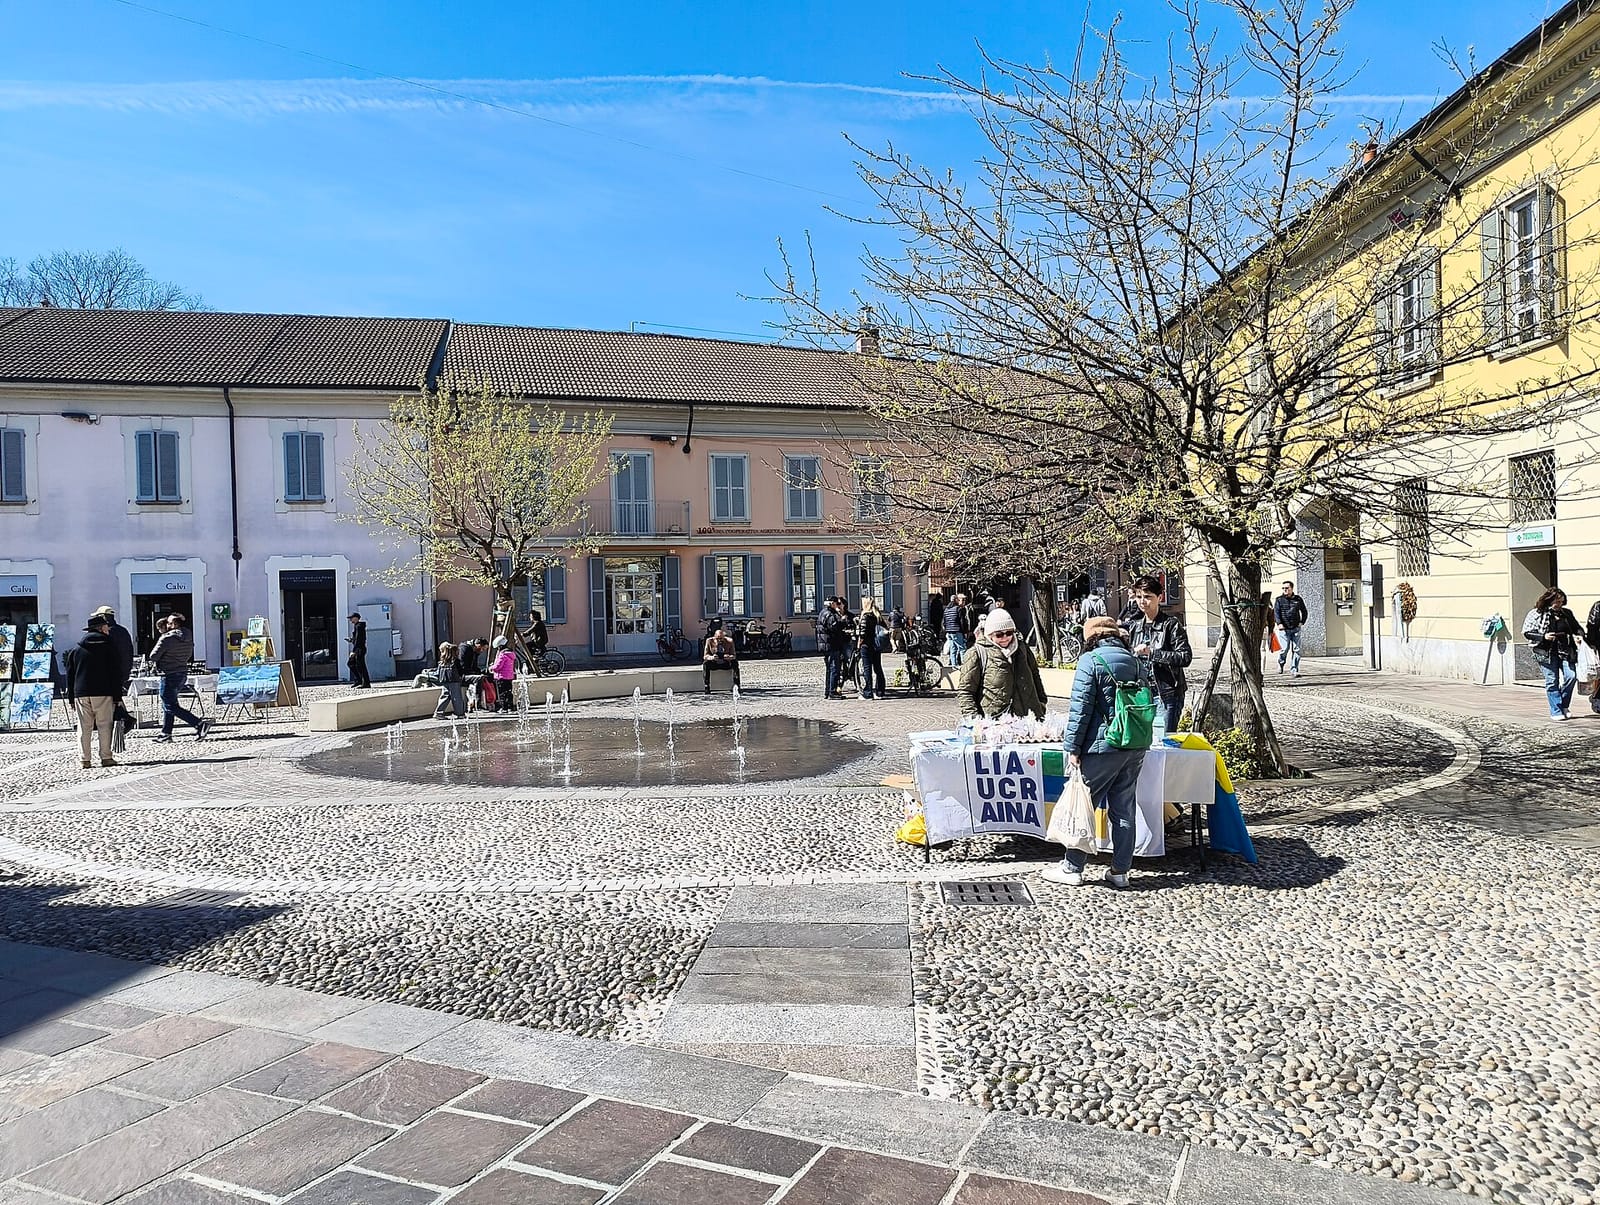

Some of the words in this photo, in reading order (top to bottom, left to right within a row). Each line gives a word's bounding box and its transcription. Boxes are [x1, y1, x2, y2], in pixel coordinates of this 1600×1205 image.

[974, 751, 1024, 775] LIA
[976, 777, 1038, 801] UCR
[980, 801, 1041, 827] AINA
